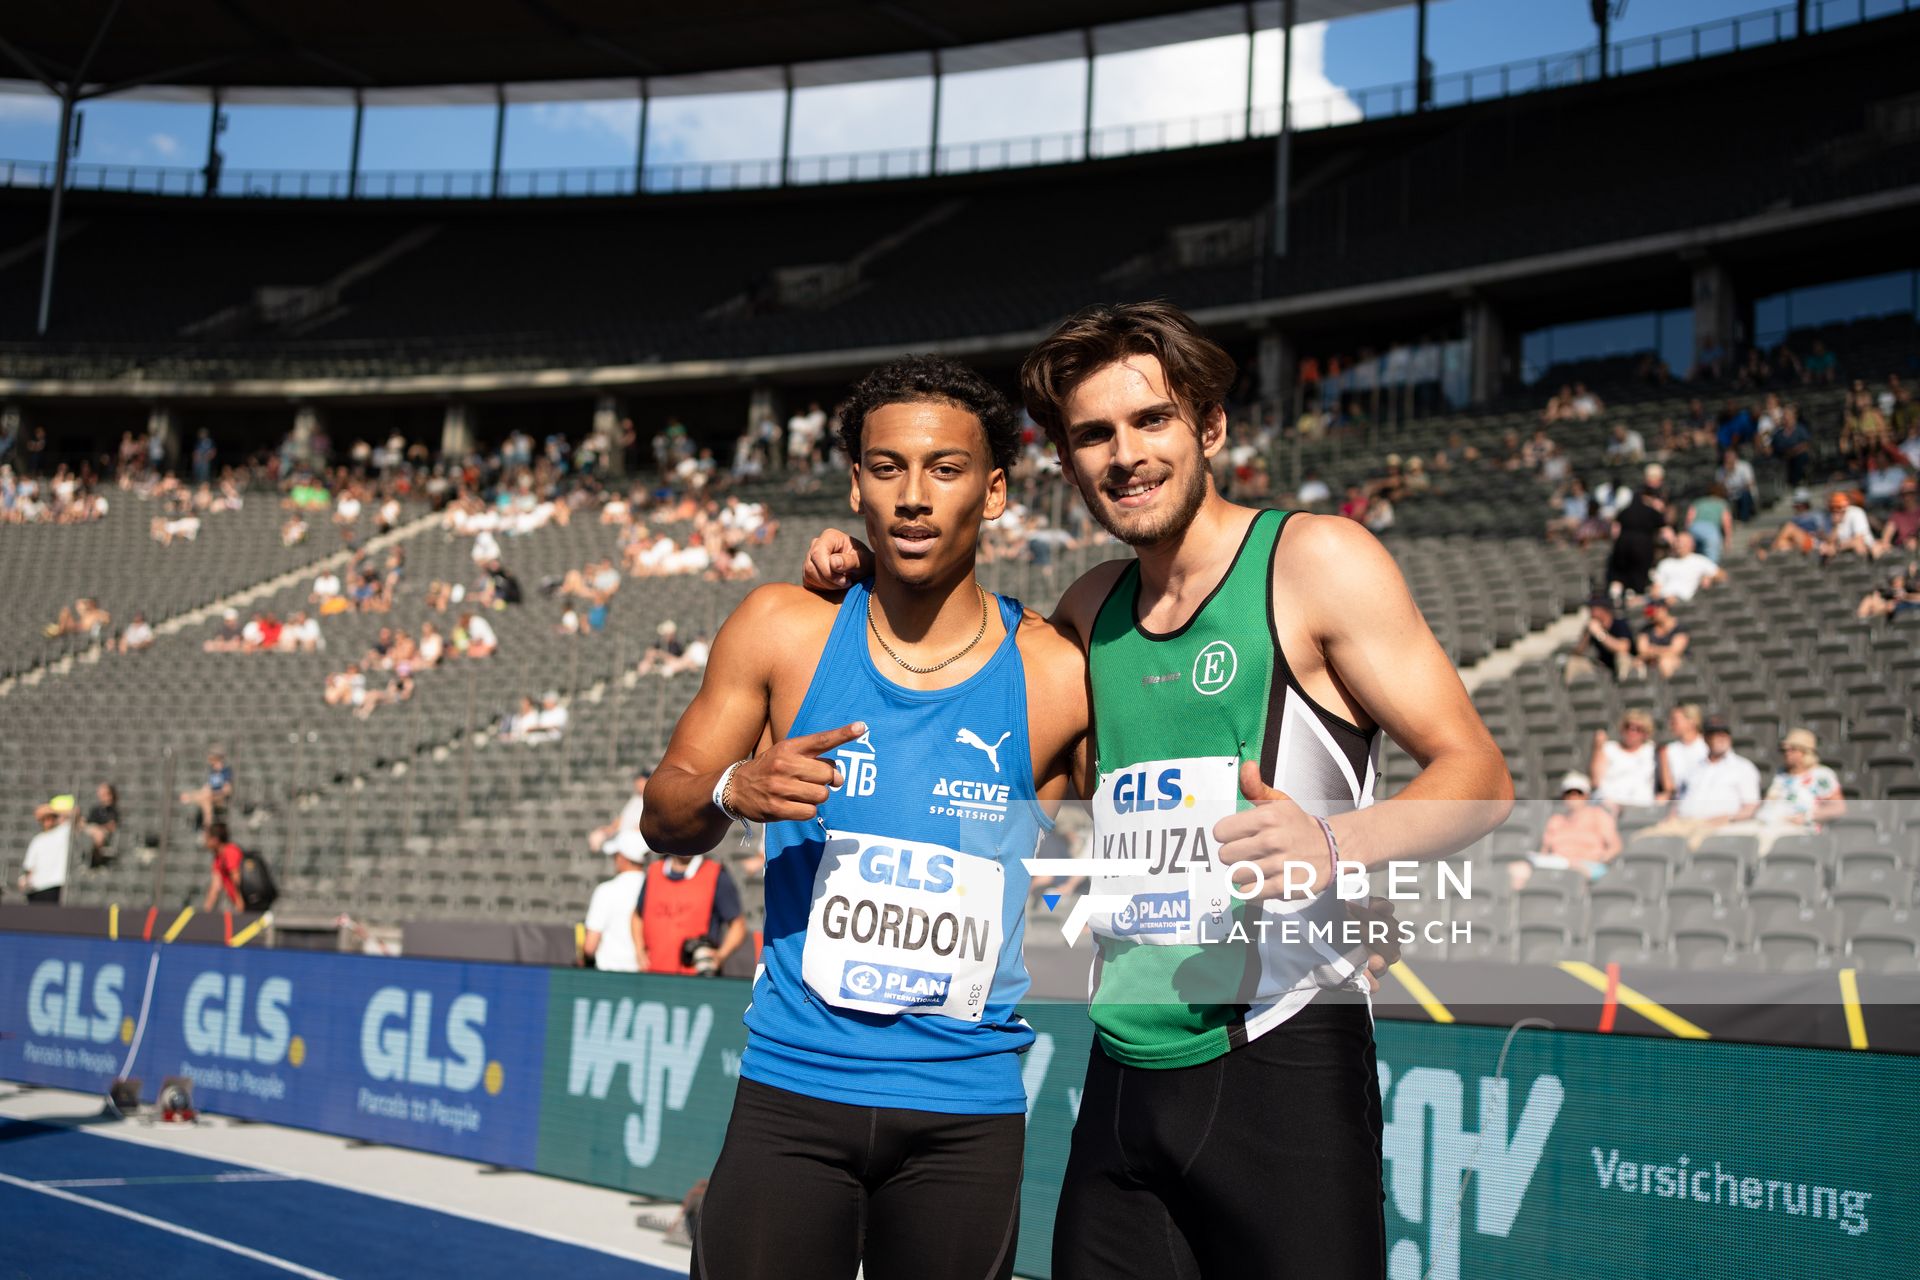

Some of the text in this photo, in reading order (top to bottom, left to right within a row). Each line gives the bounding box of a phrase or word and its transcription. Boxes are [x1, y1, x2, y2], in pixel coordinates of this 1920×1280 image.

[1200, 651, 1225, 684] E
[929, 805, 1006, 823] SPORTSHOP
[1139, 899, 1187, 920] PLAN
[1210, 898, 1224, 926] 315
[822, 894, 990, 962] GORDON
[884, 972, 946, 996] PLAN
[967, 983, 982, 1007] 335
[883, 991, 940, 1004] INTERNATIONAL
[358, 1087, 481, 1135] Parcels to People
[1591, 1146, 1872, 1236] Versicherung
